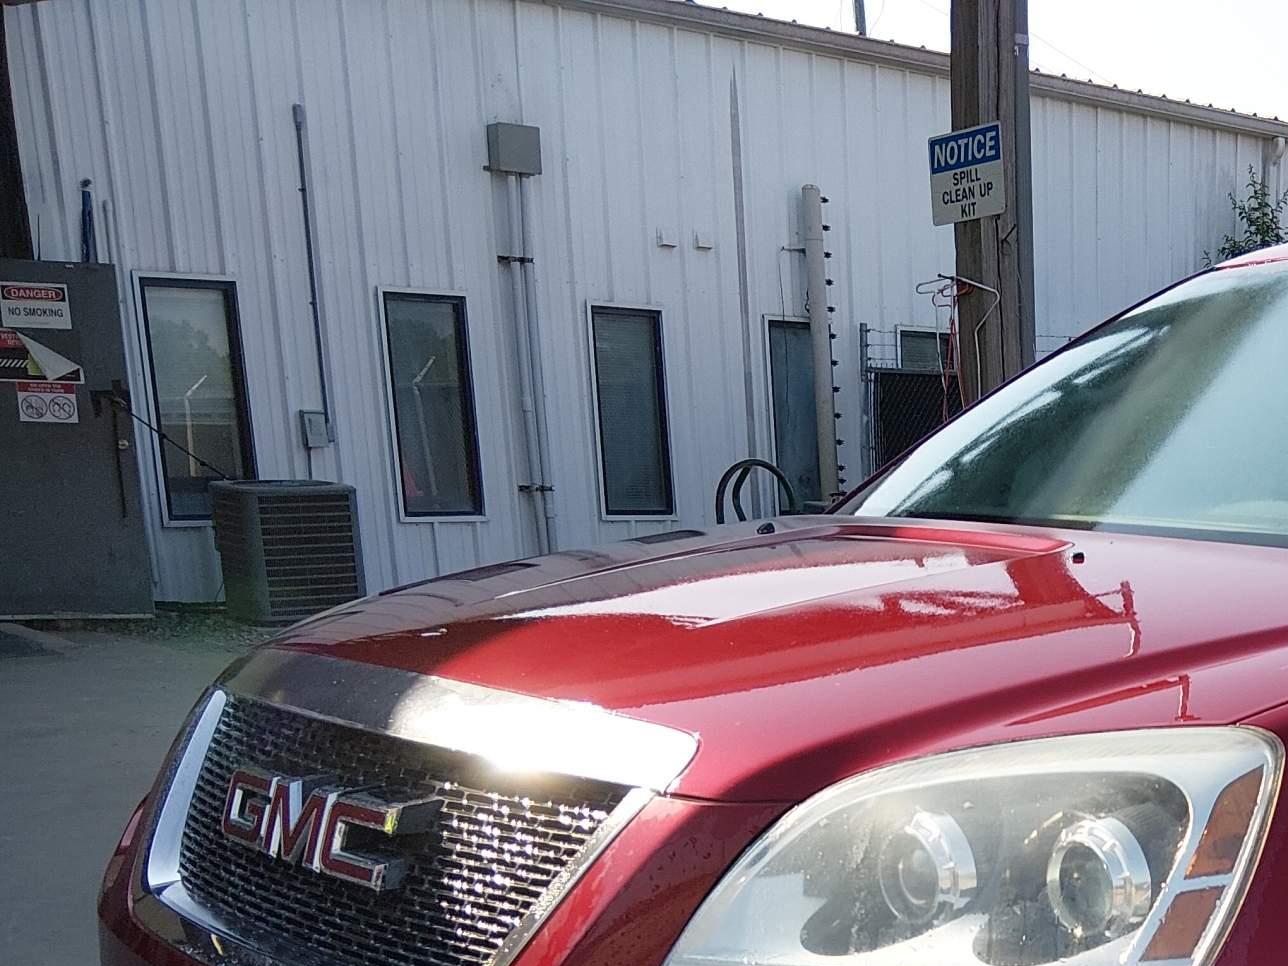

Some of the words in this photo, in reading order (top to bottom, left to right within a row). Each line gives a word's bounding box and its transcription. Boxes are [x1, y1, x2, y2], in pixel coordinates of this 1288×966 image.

[934, 131, 996, 168] NOTICE
[952, 167, 981, 186] SPILL
[942, 185, 975, 205] CLEAN
[979, 182, 993, 198] UP
[960, 202, 977, 218] KIT
[10, 288, 56, 299] DANGER
[8, 306, 21, 316] NO
[22, 307, 64, 318] SMOKING
[221, 769, 402, 895] GMC
